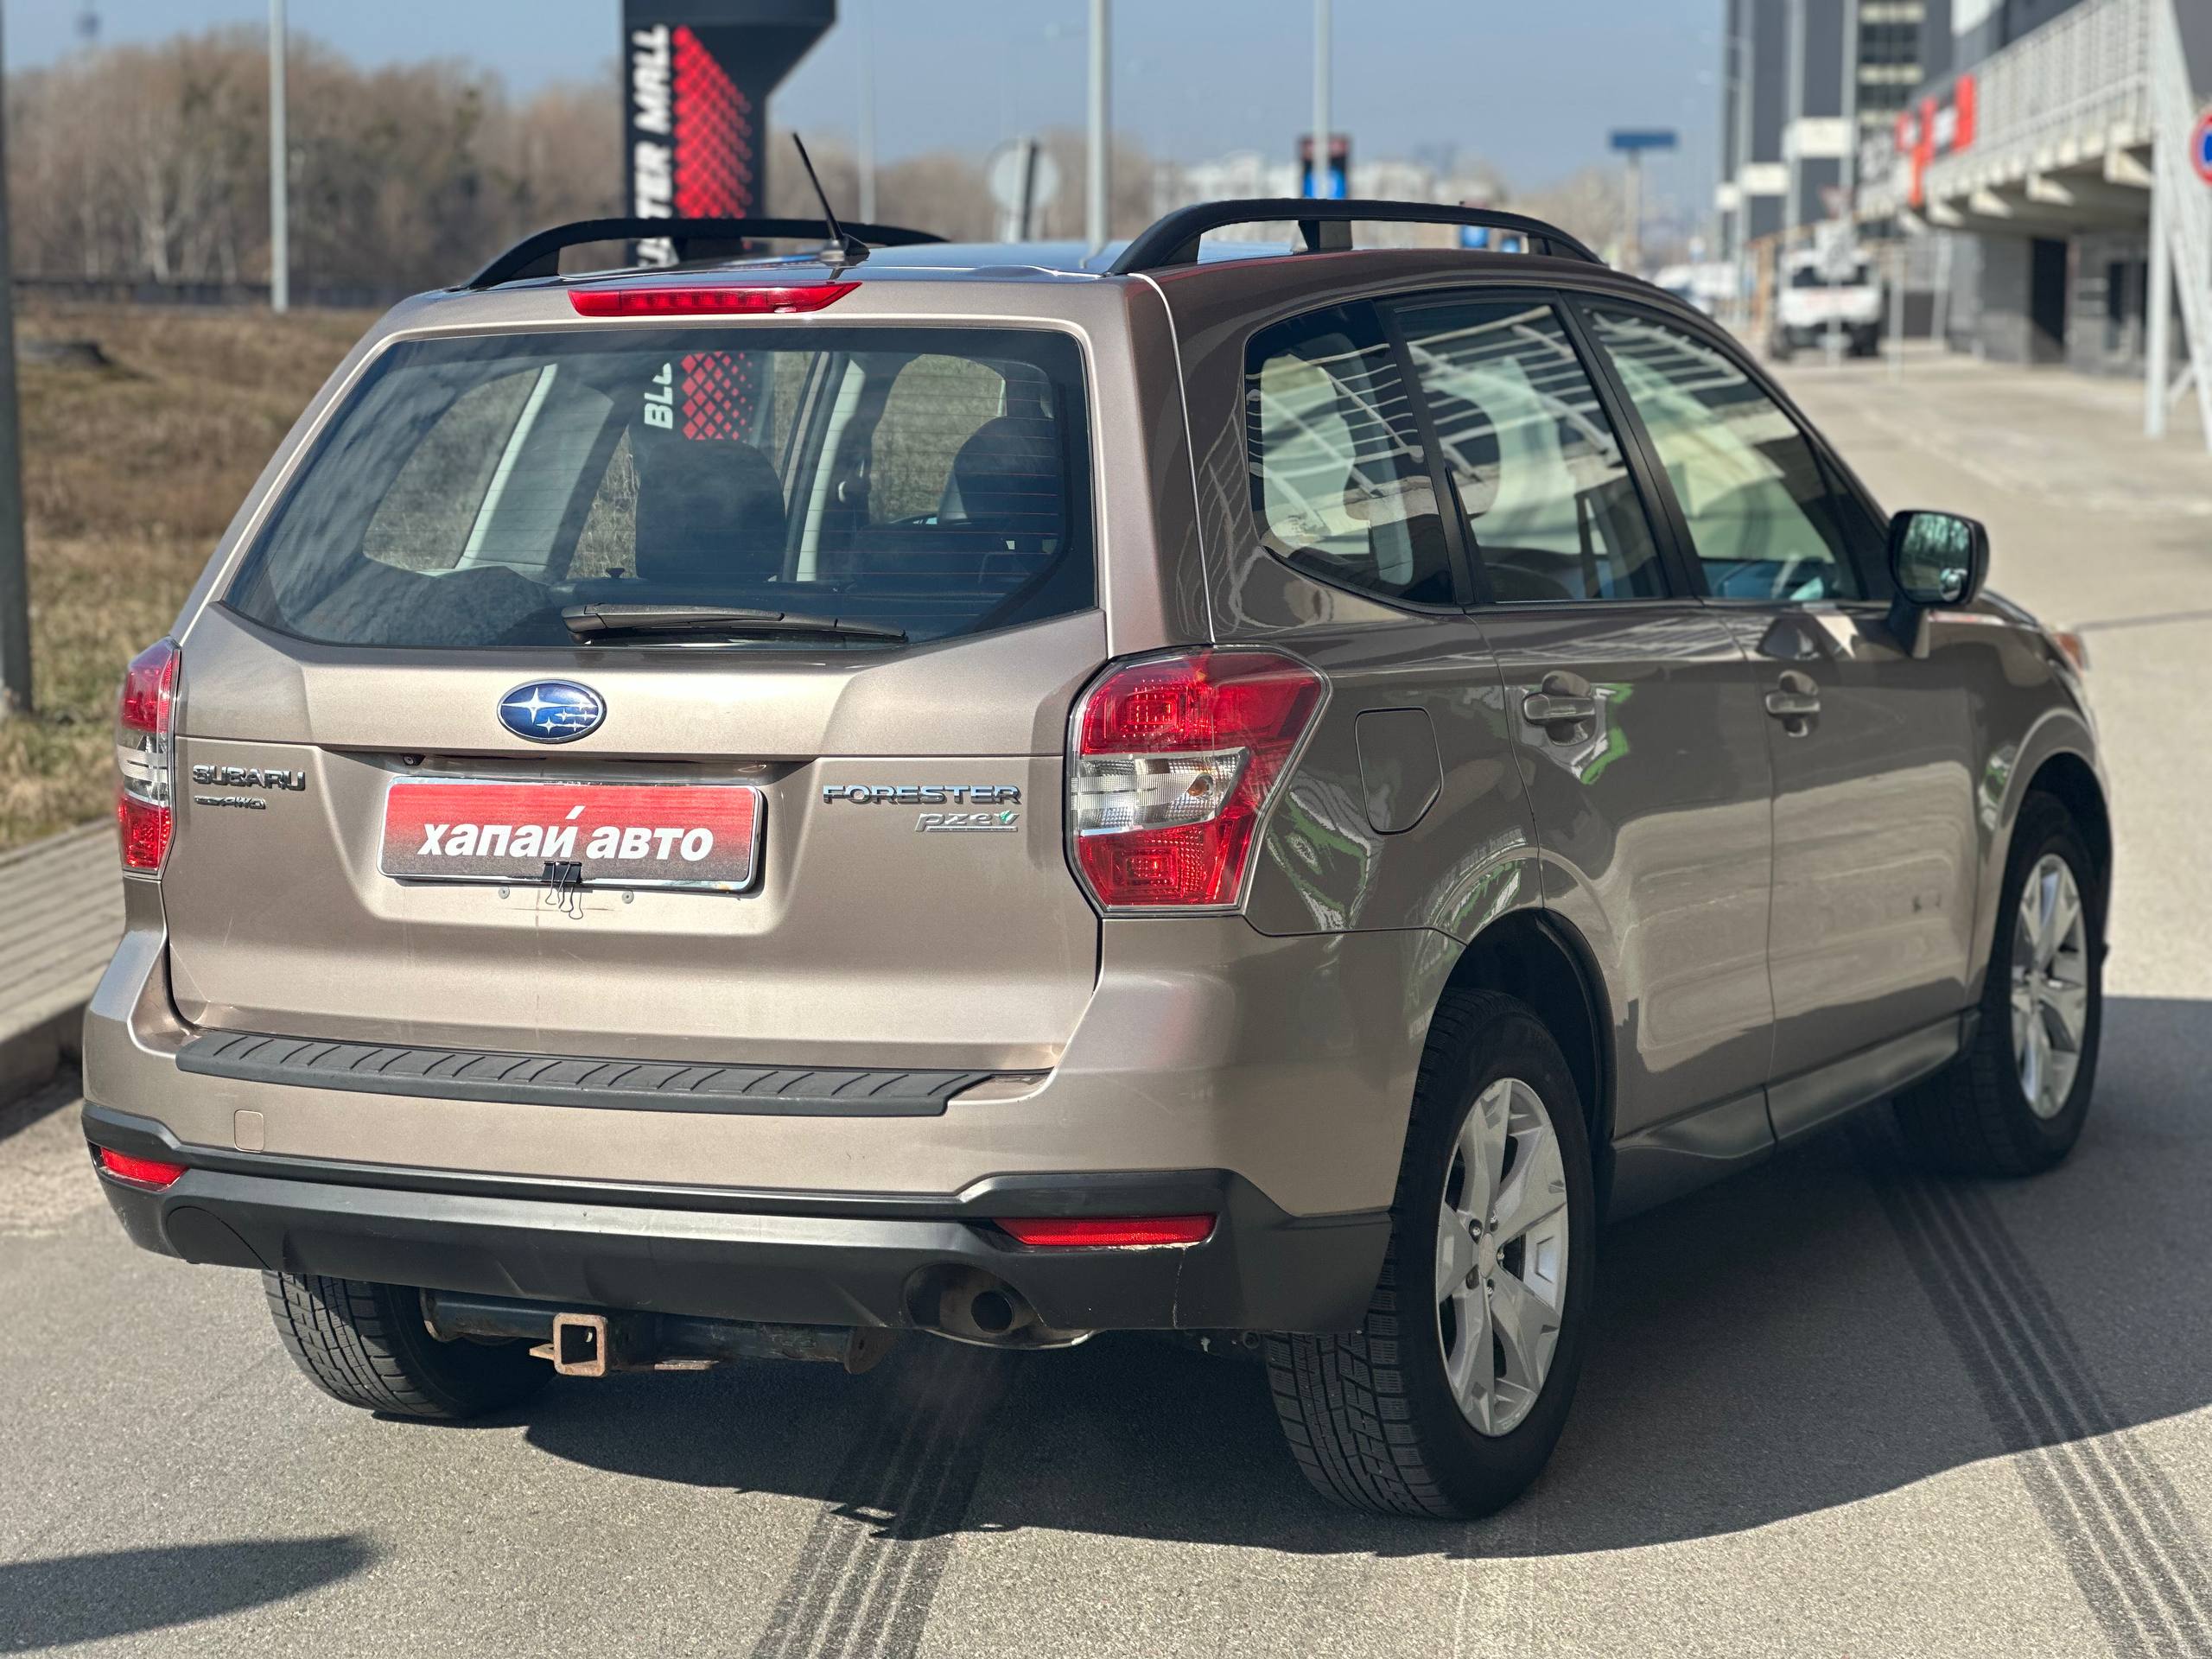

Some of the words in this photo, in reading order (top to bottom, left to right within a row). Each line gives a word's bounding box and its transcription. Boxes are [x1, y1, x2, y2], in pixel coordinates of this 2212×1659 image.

[632, 23, 671, 135] MALL
[193, 765, 305, 791] SUBARU
[823, 785, 1022, 805] FORESTER
[417, 805, 585, 857] хапай
[586, 824, 714, 861] авто
